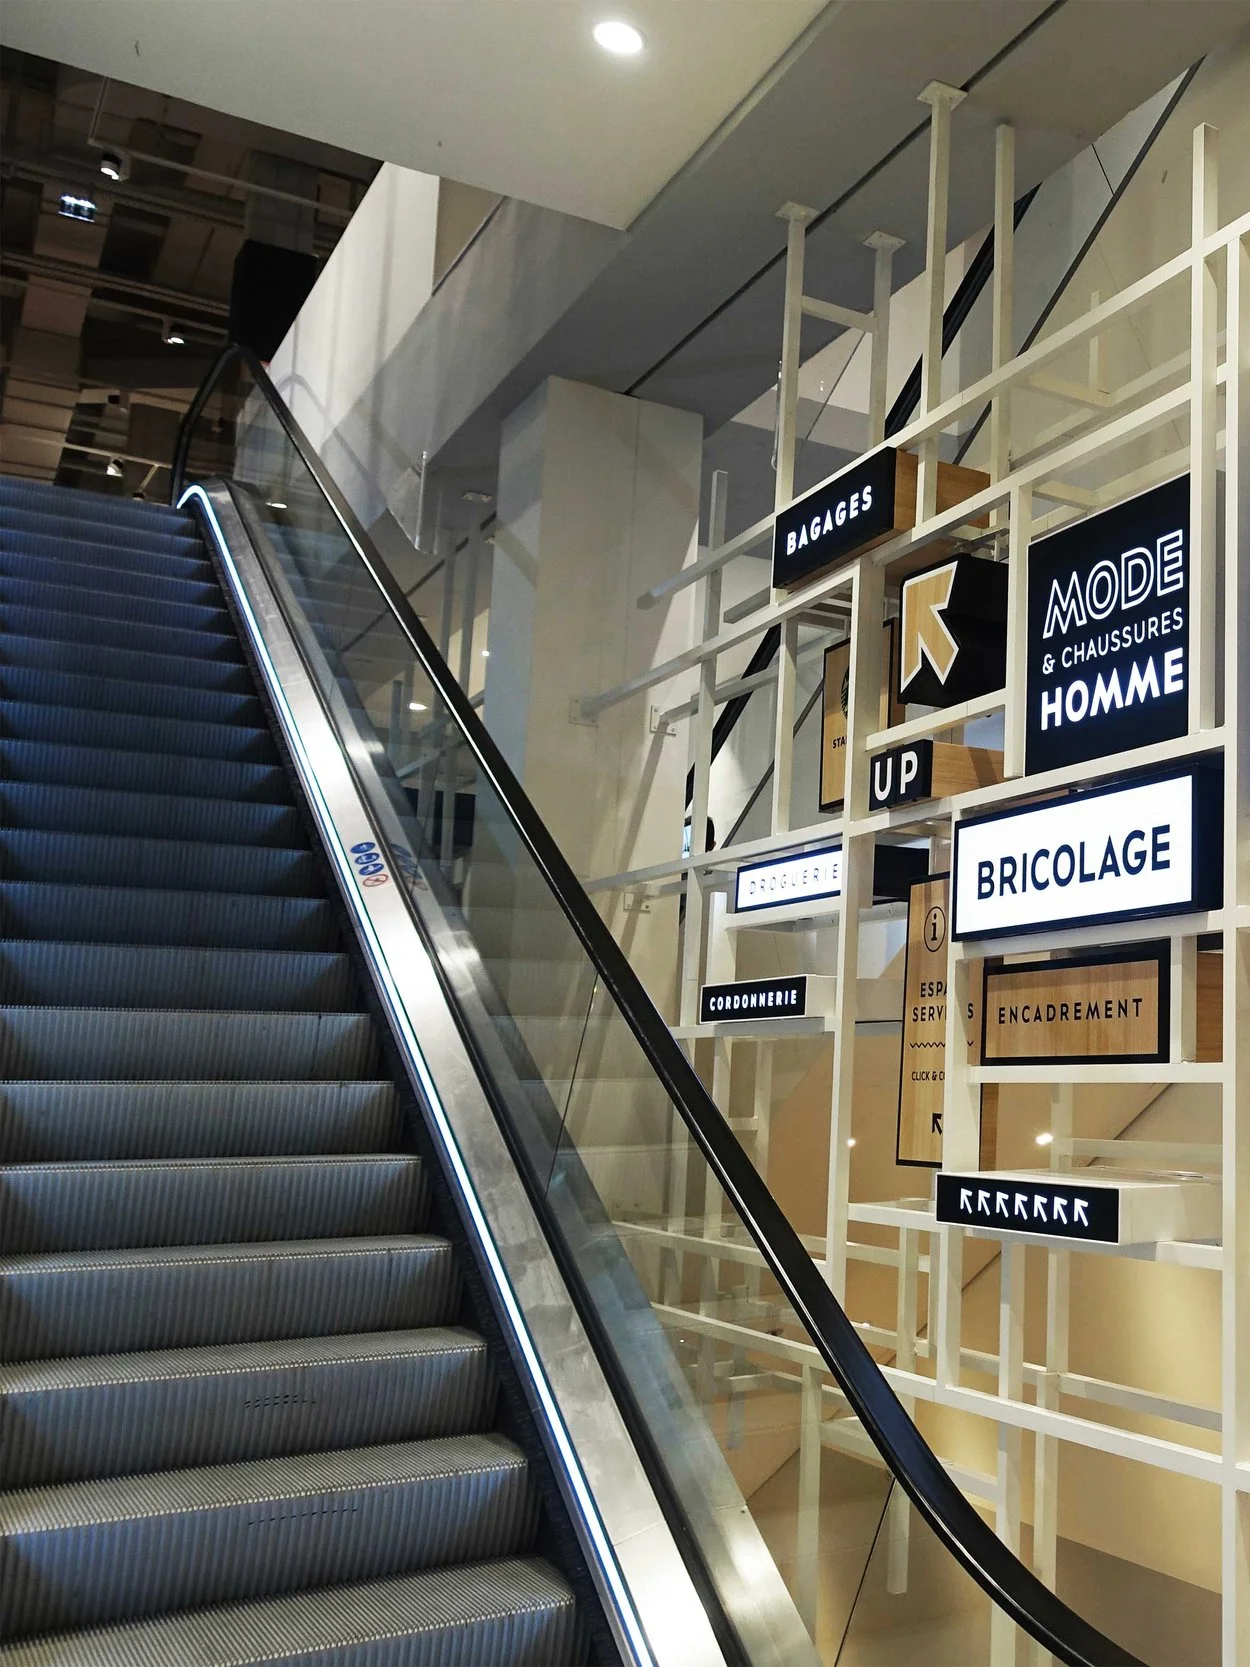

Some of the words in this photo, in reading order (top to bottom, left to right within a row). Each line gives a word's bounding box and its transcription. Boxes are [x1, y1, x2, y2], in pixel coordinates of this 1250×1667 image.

[786, 485, 872, 556] BAGAGES
[1042, 529, 1184, 639] MODE
[1042, 653, 1056, 675] &
[1061, 607, 1184, 668] CHAUSSURES
[1041, 647, 1184, 731] HOMME
[874, 750, 919, 801] UP
[749, 863, 838, 895] DROGUERIE
[977, 824, 1170, 900] BRICOLAGE
[709, 989, 797, 1011] CORDONNERIE
[998, 998, 1143, 1024] ENCADREMENT
[911, 1070, 930, 1081] CLICK
